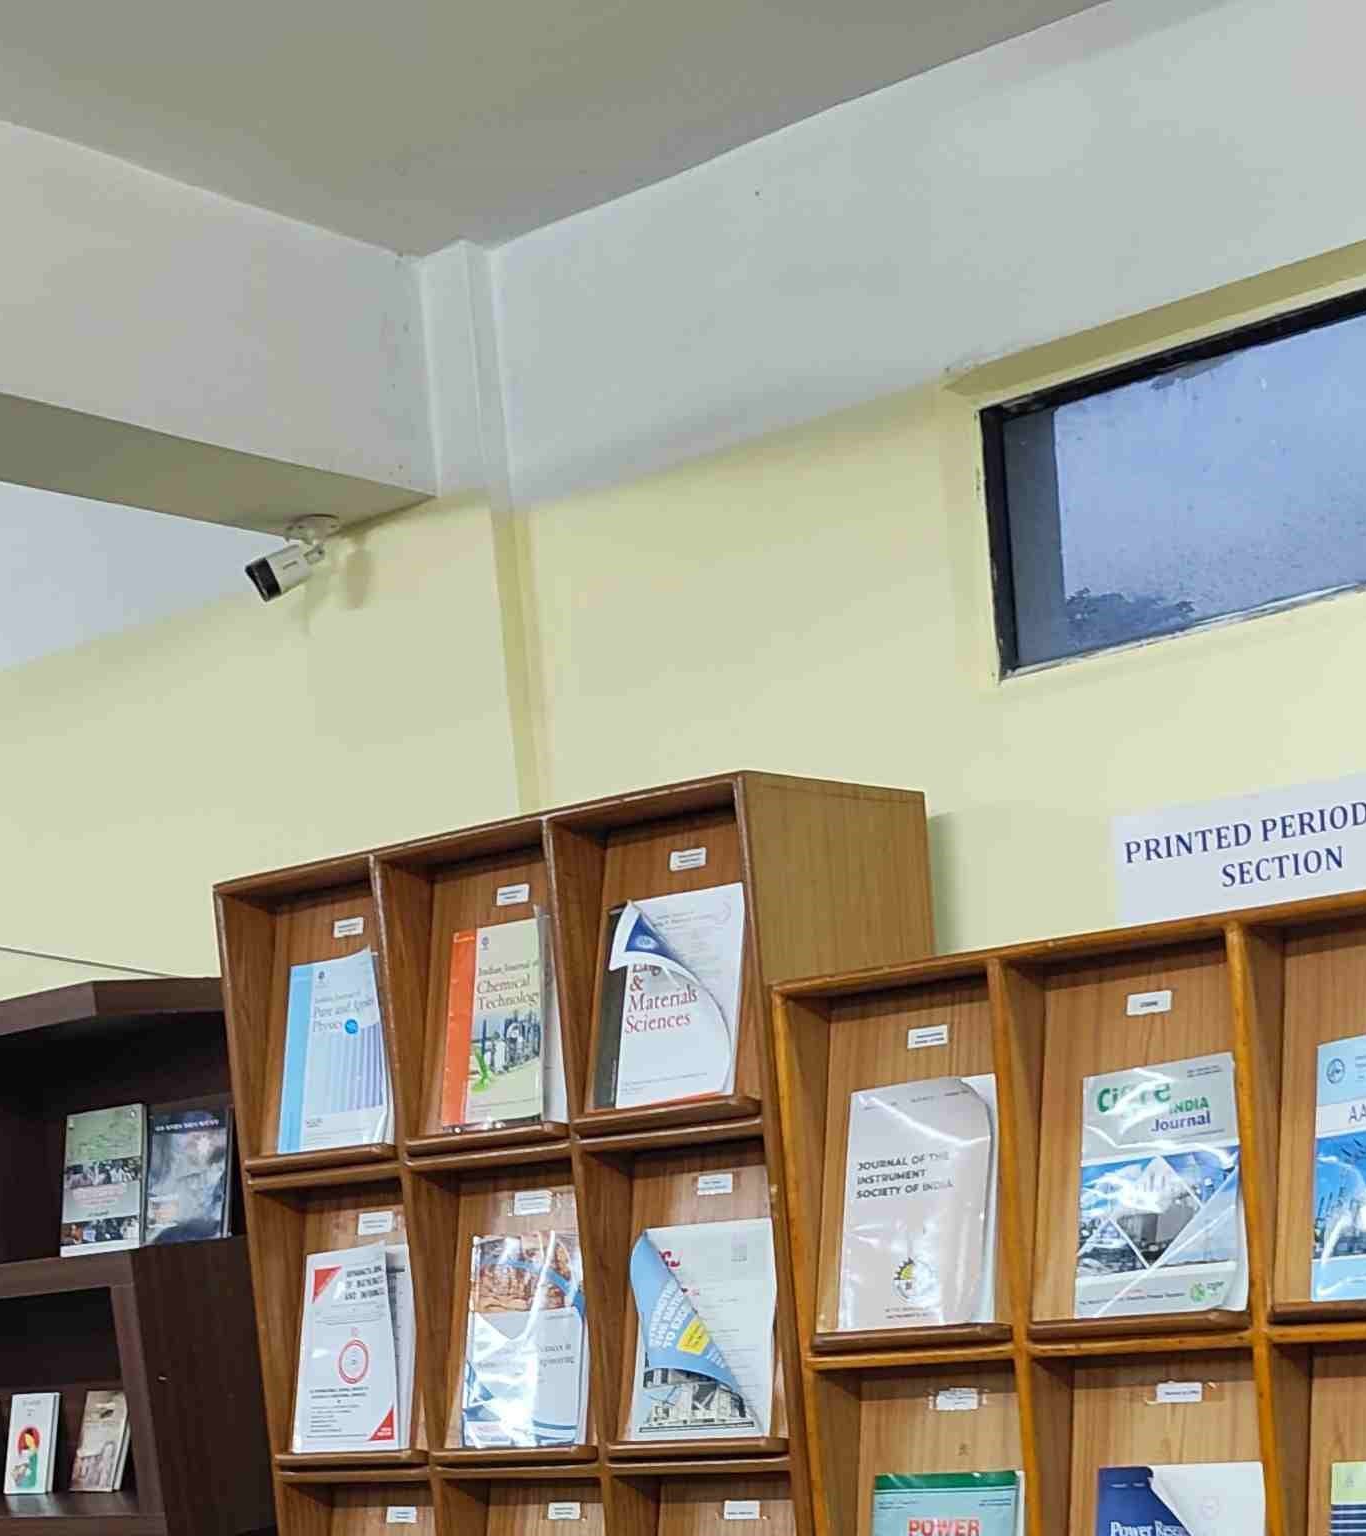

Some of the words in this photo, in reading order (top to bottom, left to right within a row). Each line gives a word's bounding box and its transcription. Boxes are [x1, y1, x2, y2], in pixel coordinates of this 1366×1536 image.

[1125, 822, 1252, 864] PRINTED
[1221, 845, 1344, 887] SECTION
[476, 975, 531, 995] Chemical
[630, 975, 643, 992] &
[628, 985, 698, 1013] Materials
[625, 1012, 691, 1033] Sciences
[1097, 1083, 1171, 1113] Cire
[1169, 1097, 1210, 1115] INDIA
[1151, 1112, 1211, 1132] Journal
[857, 1158, 908, 1171] JOURNAL
[857, 1168, 927, 1185] INSTRUMENT
[856, 1186, 901, 1199] SOCIETY
